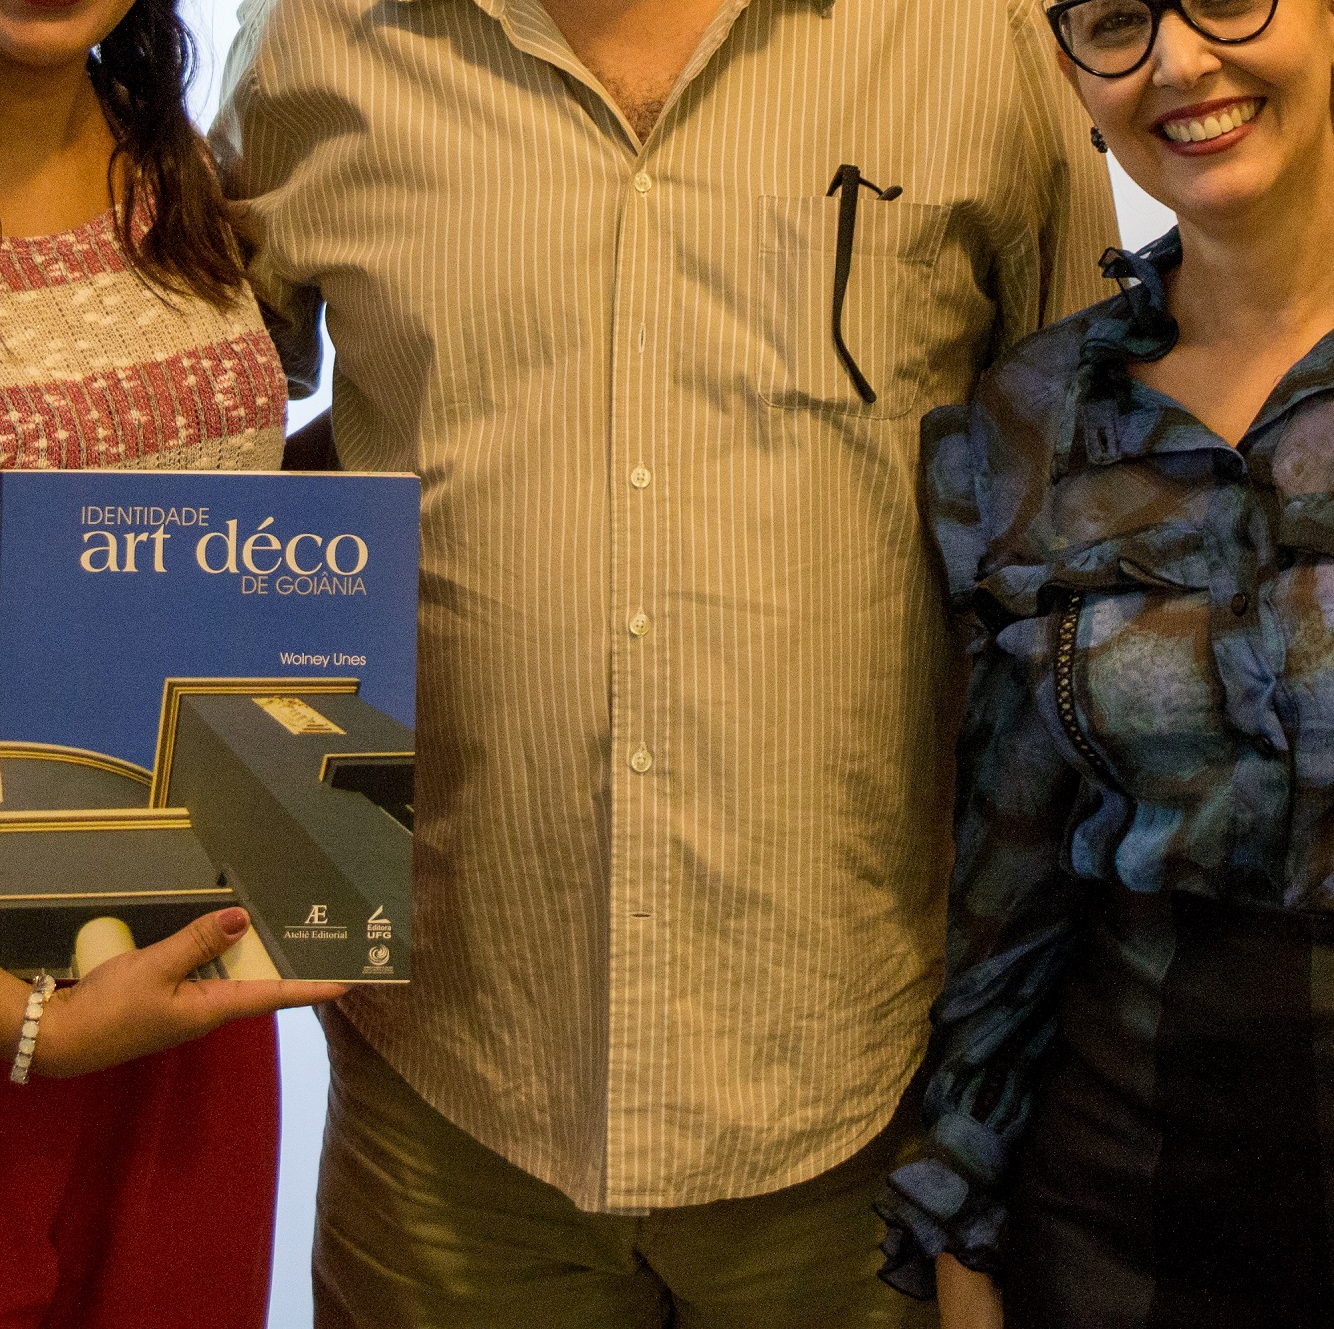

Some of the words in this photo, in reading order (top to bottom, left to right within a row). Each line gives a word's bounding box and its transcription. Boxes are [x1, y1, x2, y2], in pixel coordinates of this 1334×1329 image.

[81, 506, 210, 527] IDENTIDADE
[80, 524, 171, 573] art
[195, 516, 369, 576] déco
[241, 576, 268, 595] DE
[275, 572, 367, 596] GOIÂNIA
[280, 652, 330, 668] Wolney
[333, 652, 367, 667] Unes
[284, 930, 310, 939] Ateliê
[311, 930, 348, 939] Editorial
[367, 931, 392, 939] UFG
